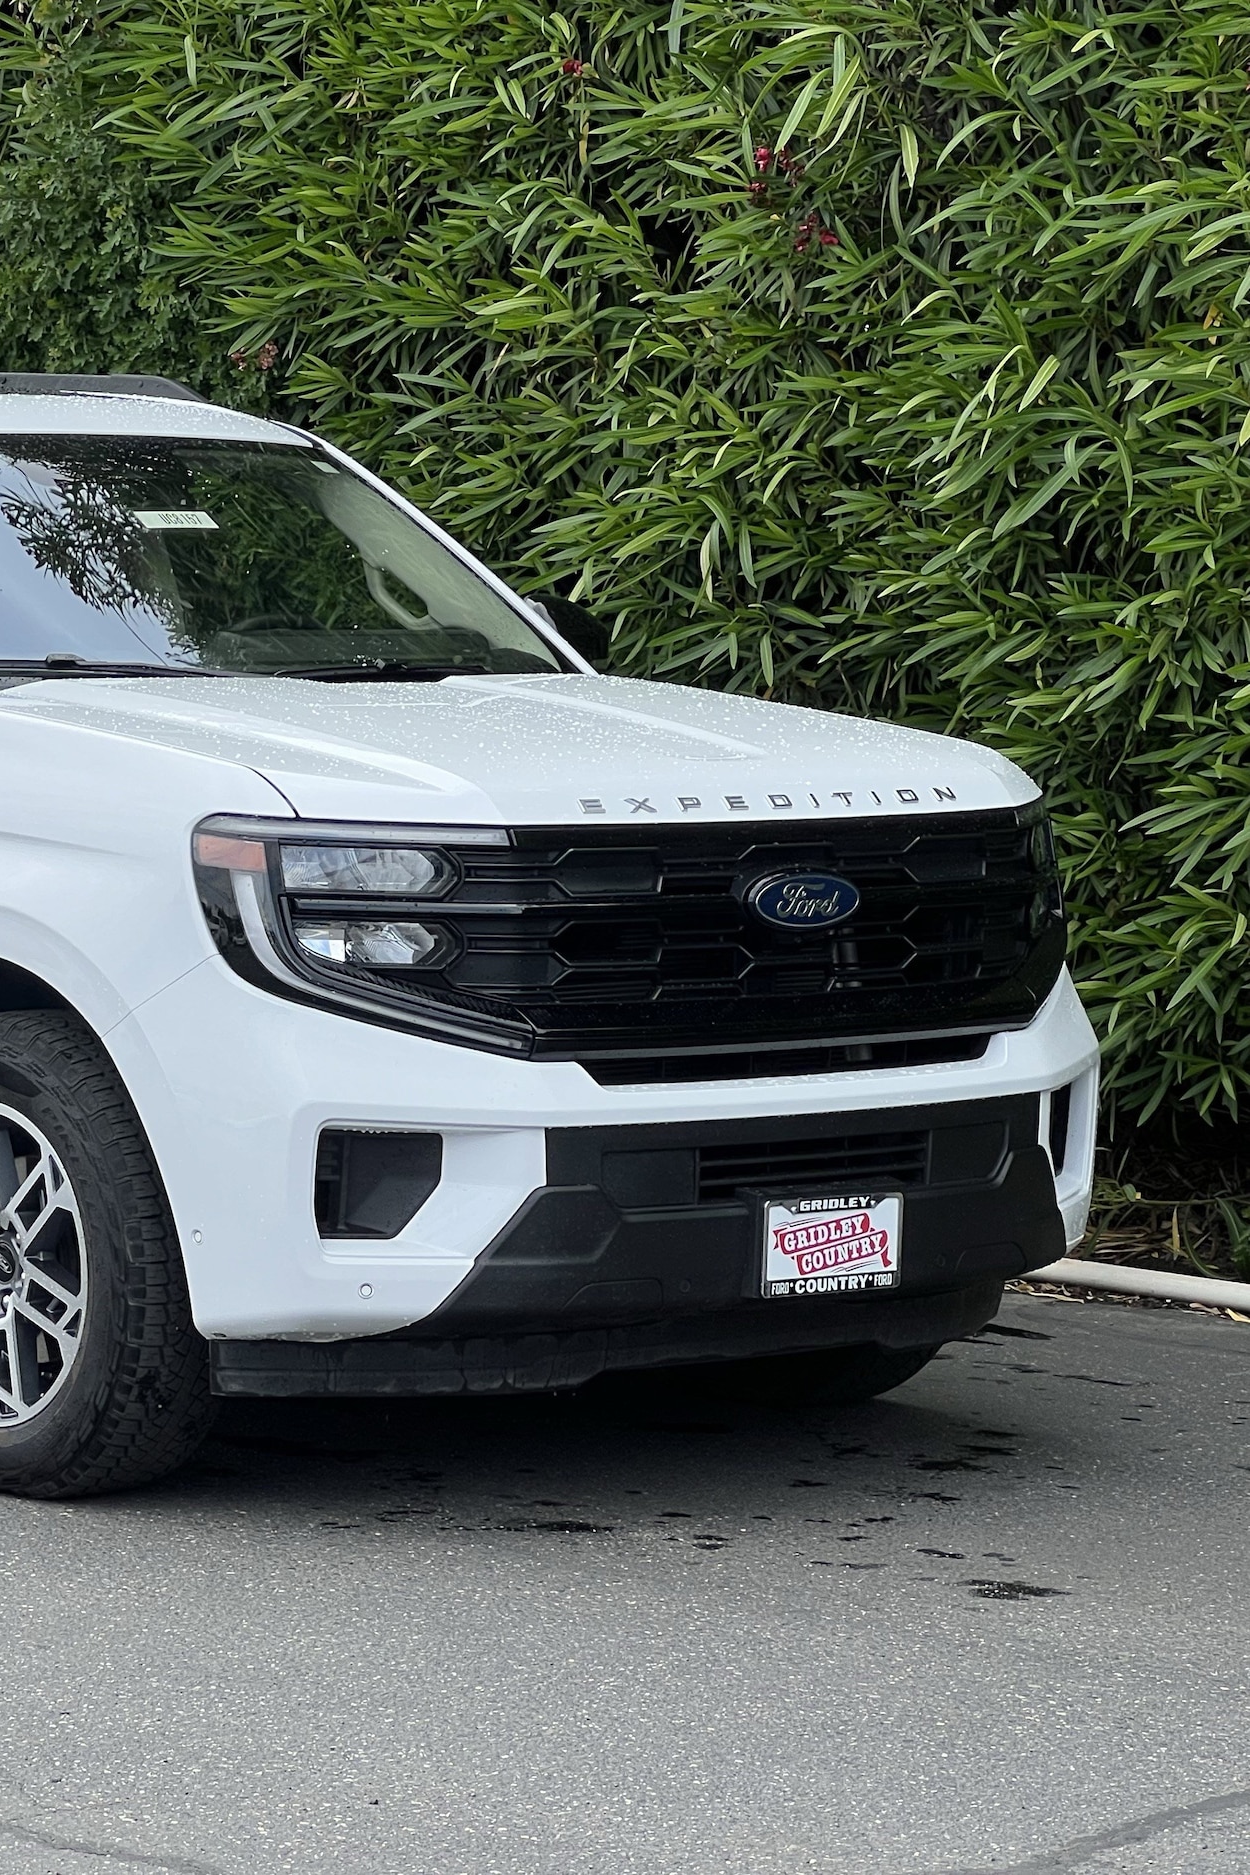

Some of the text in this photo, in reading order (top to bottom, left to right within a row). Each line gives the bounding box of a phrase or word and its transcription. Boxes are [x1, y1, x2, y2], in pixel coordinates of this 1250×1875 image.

[578, 785, 957, 815] EXPEDITION
[776, 882, 841, 918] Ford
[799, 1196, 870, 1212] GRIDLEY
[783, 1214, 865, 1251] GRIDLEY
[801, 1233, 884, 1273] COUNTRY
[771, 1273, 893, 1296] FORD COUNTRY FORD
